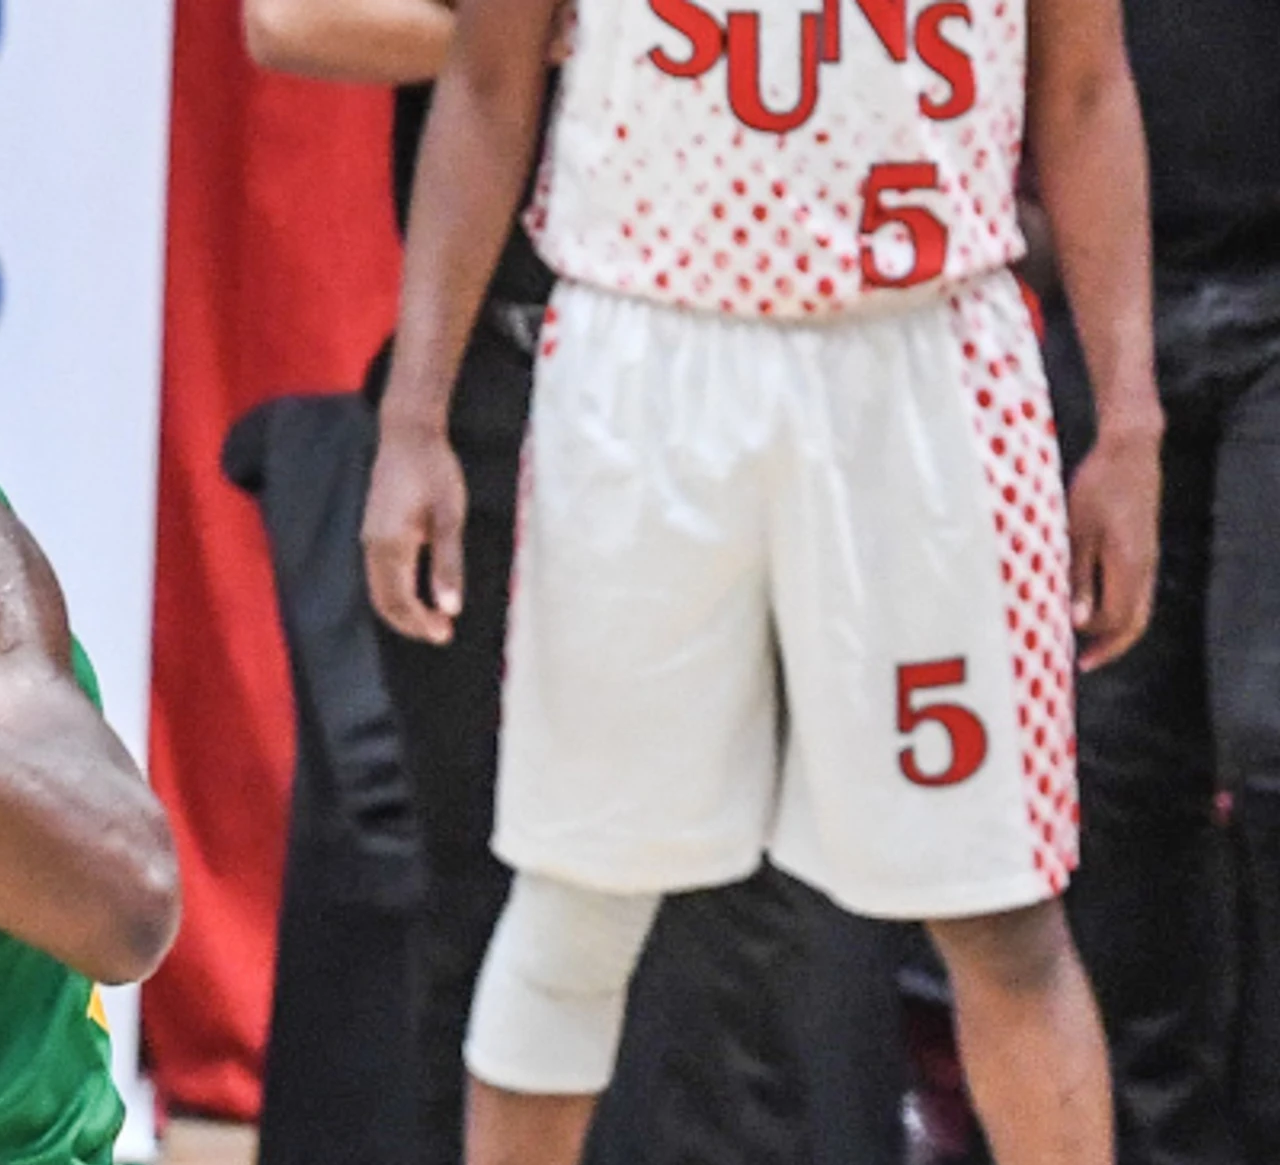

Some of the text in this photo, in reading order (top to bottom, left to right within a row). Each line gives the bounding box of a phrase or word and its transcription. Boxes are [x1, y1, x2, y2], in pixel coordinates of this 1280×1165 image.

[647, 0, 976, 133] SUNS
[858, 162, 948, 288] 5
[895, 655, 989, 788] 5
